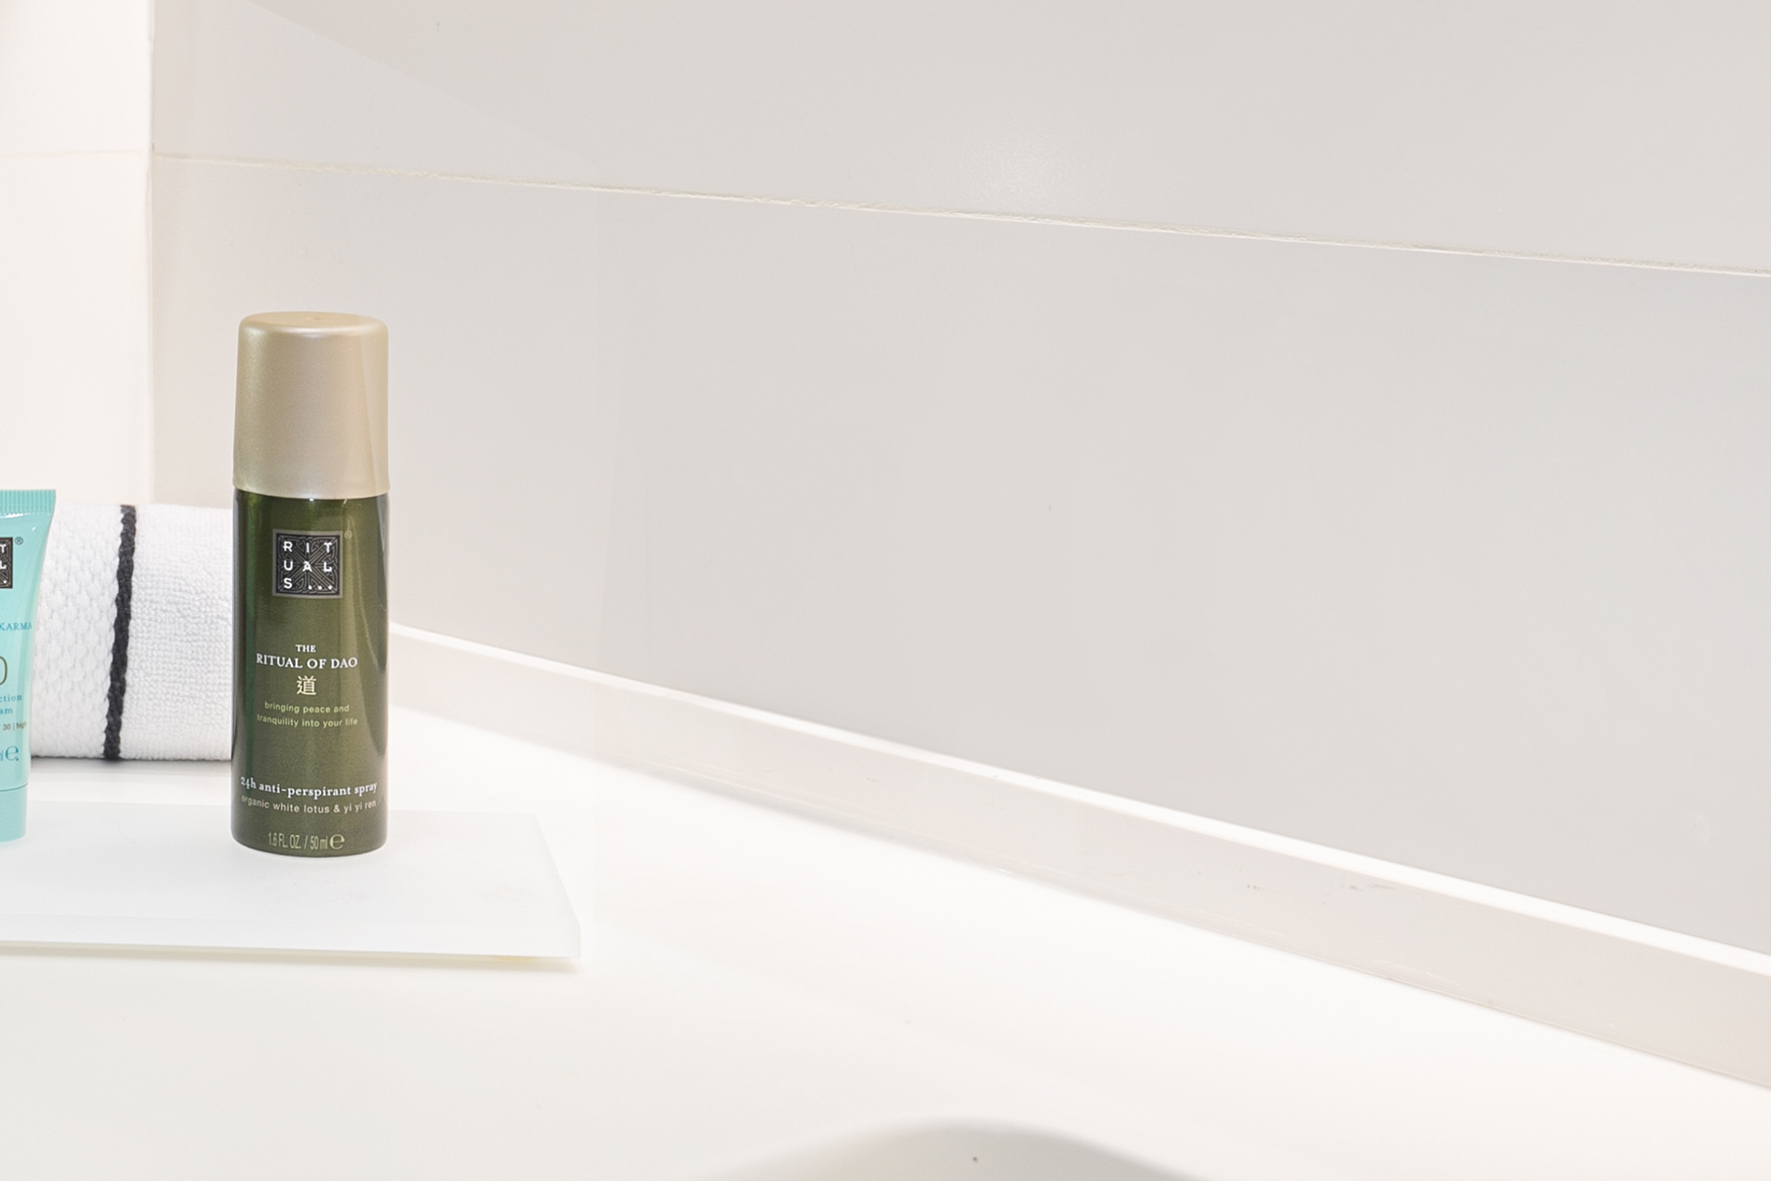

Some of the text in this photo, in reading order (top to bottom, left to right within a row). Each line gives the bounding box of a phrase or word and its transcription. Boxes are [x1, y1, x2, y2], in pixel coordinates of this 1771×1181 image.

[295, 644, 317, 653] THE
[256, 653, 358, 669] RITUAL OF DAO
[296, 675, 317, 696] 道
[264, 701, 350, 714] bringing peace and
[257, 714, 358, 729] tranquility into your life
[240, 776, 378, 800] 24h anti-perspirant spray
[241, 794, 377, 815] organic white lotus & yi yi ren
[268, 831, 278, 847] 1.6
[309, 835, 319, 850] 50
